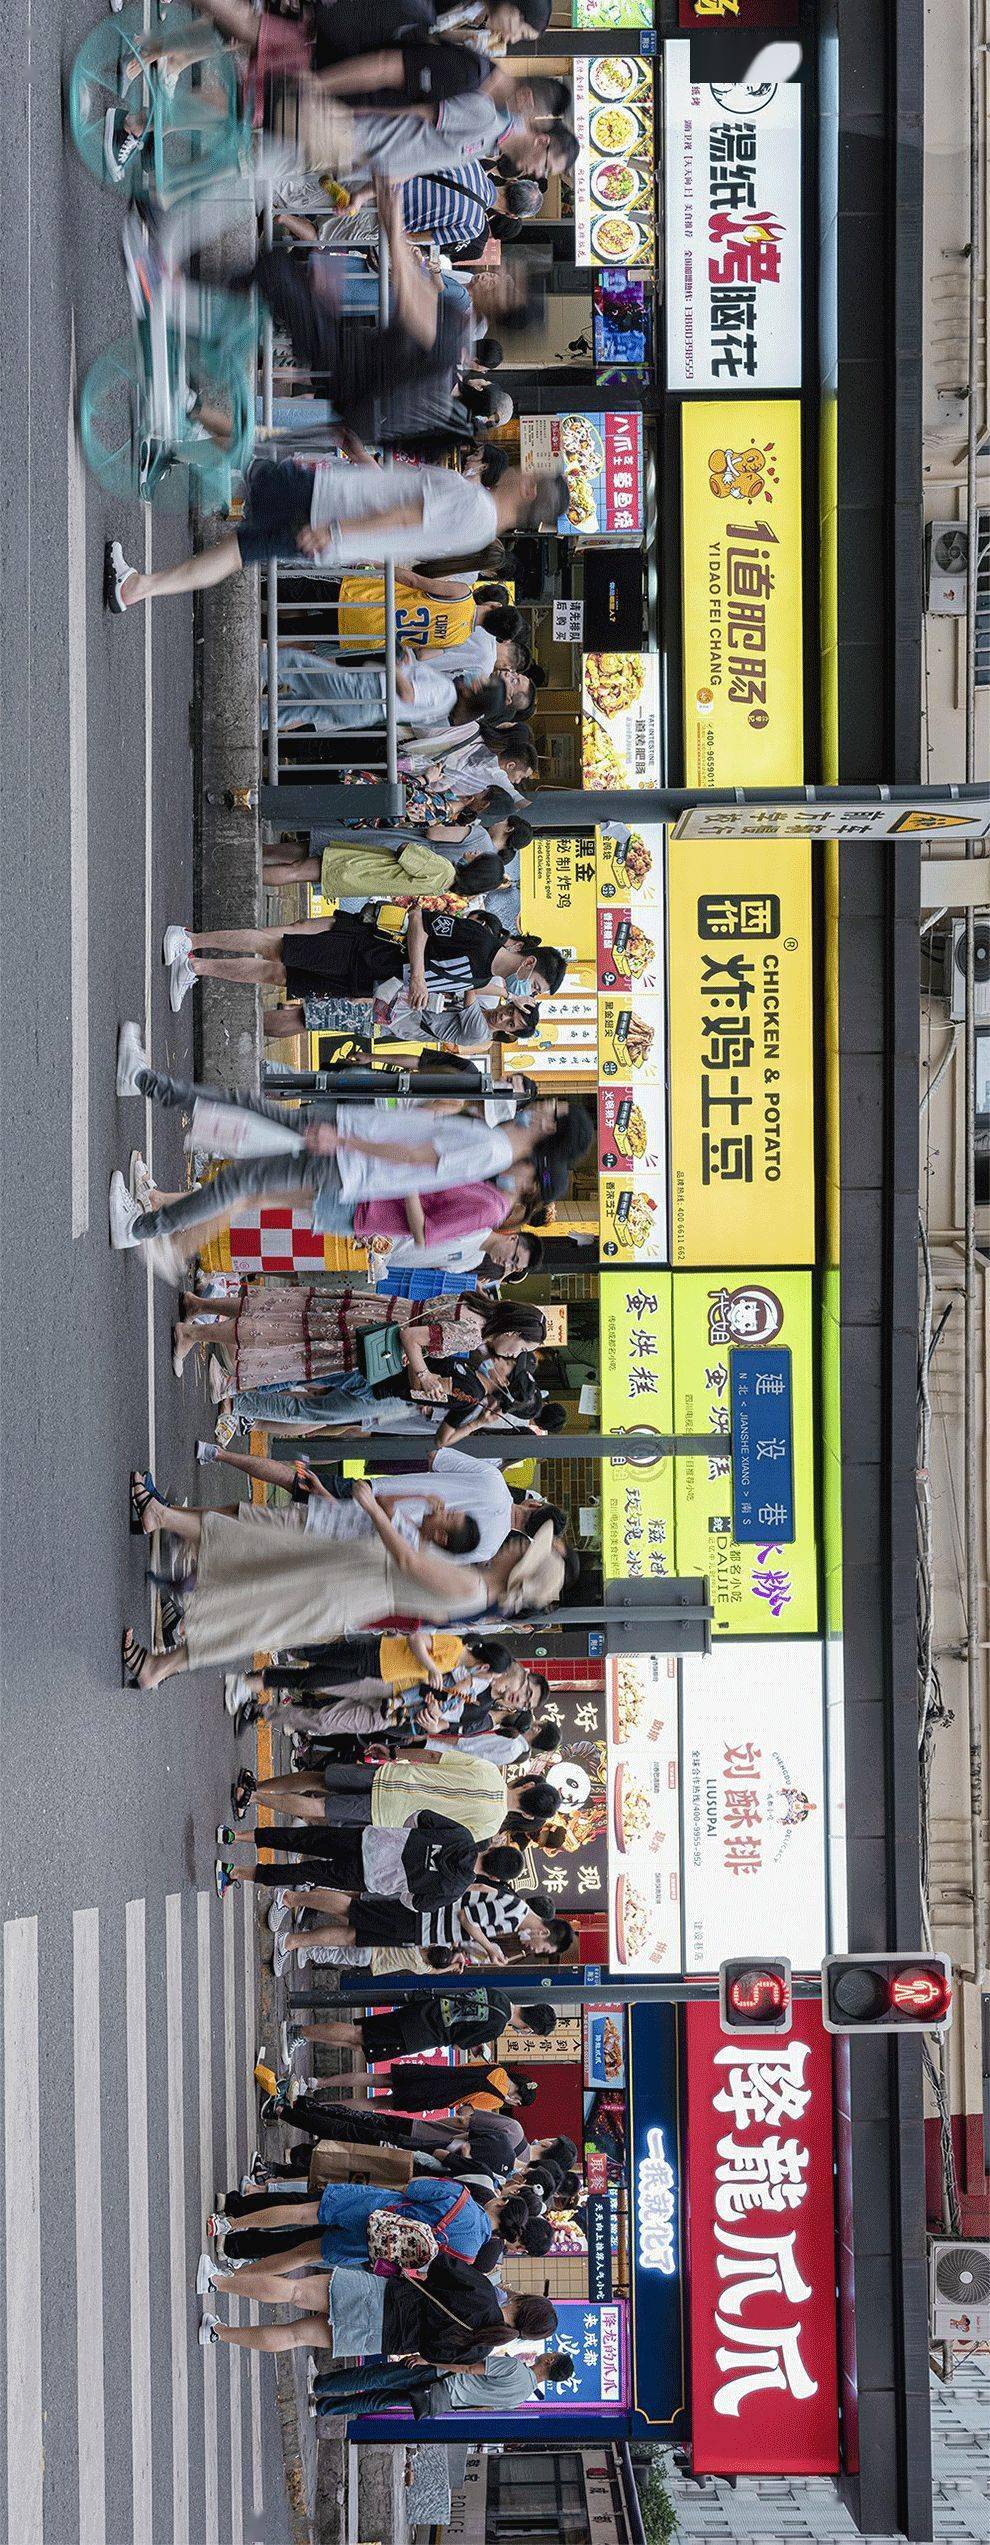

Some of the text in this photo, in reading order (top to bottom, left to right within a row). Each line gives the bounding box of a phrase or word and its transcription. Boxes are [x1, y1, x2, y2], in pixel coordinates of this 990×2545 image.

[707, 121, 787, 378] 锡纸烤脑花
[684, 306, 694, 379] 13880398559
[395, 607, 430, 646] 30
[434, 614, 448, 640] CURRY
[555, 601, 567, 641] 后购买
[569, 601, 581, 642] 请先排队
[709, 542, 723, 686] YI DAO FEI CHANG
[726, 520, 780, 705] 1道肥肠
[697, 824, 873, 835] 车辆慢行
[704, 811, 885, 824] 前方学校
[555, 839, 572, 909] 秘制炸鸡
[575, 839, 595, 883] 黑金
[705, 900, 773, 934] 西作
[700, 954, 755, 1186] 炸鸡土豆
[763, 954, 780, 1182] CHICKEN & POTATO
[677, 1245, 685, 1261] 662
[607, 1315, 616, 1371] 传统成都名小吃
[626, 1288, 659, 1398] 蛋烘糕
[709, 1289, 730, 1346] 代姐
[739, 1385, 747, 1396] 北
[739, 1411, 749, 1454] JIANSHE
[755, 1373, 788, 1526] 建设巷
[741, 1456, 750, 1486] XIANG
[741, 1502, 751, 1513] 南
[717, 1536, 728, 1603] DAIJIE
[772, 1751, 792, 1786] CHENGDU
[706, 1779, 717, 1837] LIUSUPAI
[722, 1741, 763, 1876] 刘酥排
[773, 1828, 792, 1863] DELICACY
[590, 2158, 605, 2190] 取餐
[594, 2203, 605, 2300] 天天向上推荐人气小吃
[712, 2040, 818, 2417] 降龍爪爪
[582, 2313, 599, 2367] 来成都
[602, 2312, 618, 2394] 降龙的爪爪
[447, 2494, 467, 2535] POLICE
